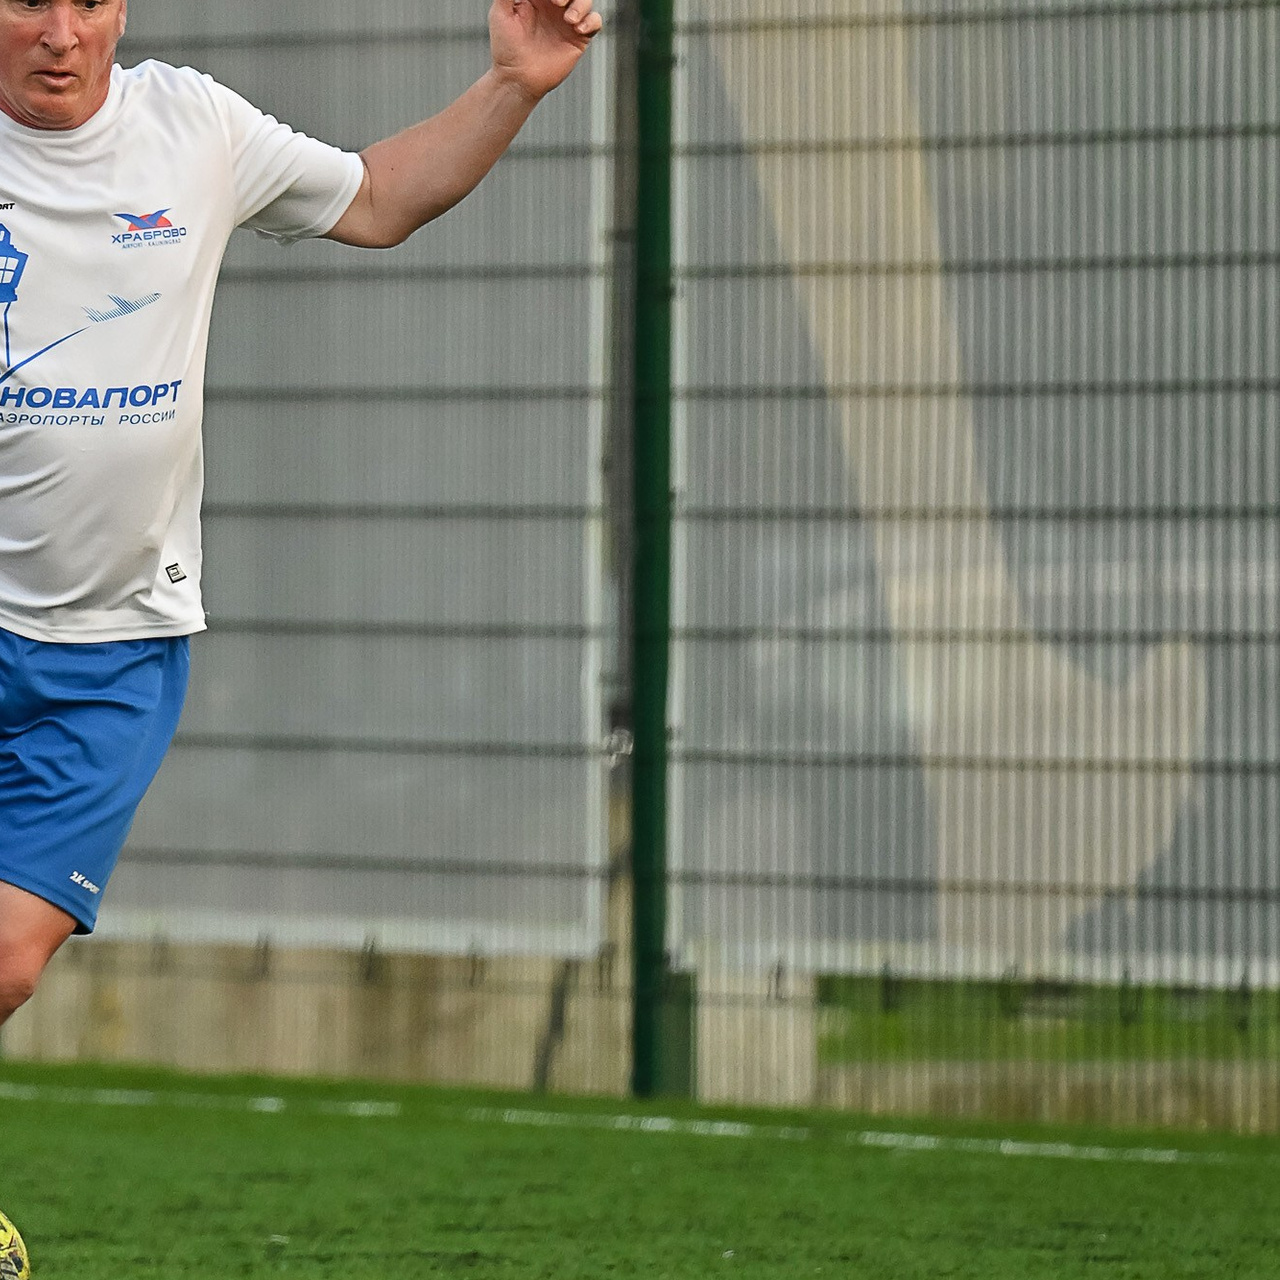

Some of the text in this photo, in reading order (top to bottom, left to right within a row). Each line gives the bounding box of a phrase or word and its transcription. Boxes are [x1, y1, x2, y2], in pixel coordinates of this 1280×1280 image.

[111, 227, 187, 244] ХРАБРОВО
[0, 379, 182, 410] НОВАПОРТ
[119, 409, 176, 424] РОССИИ
